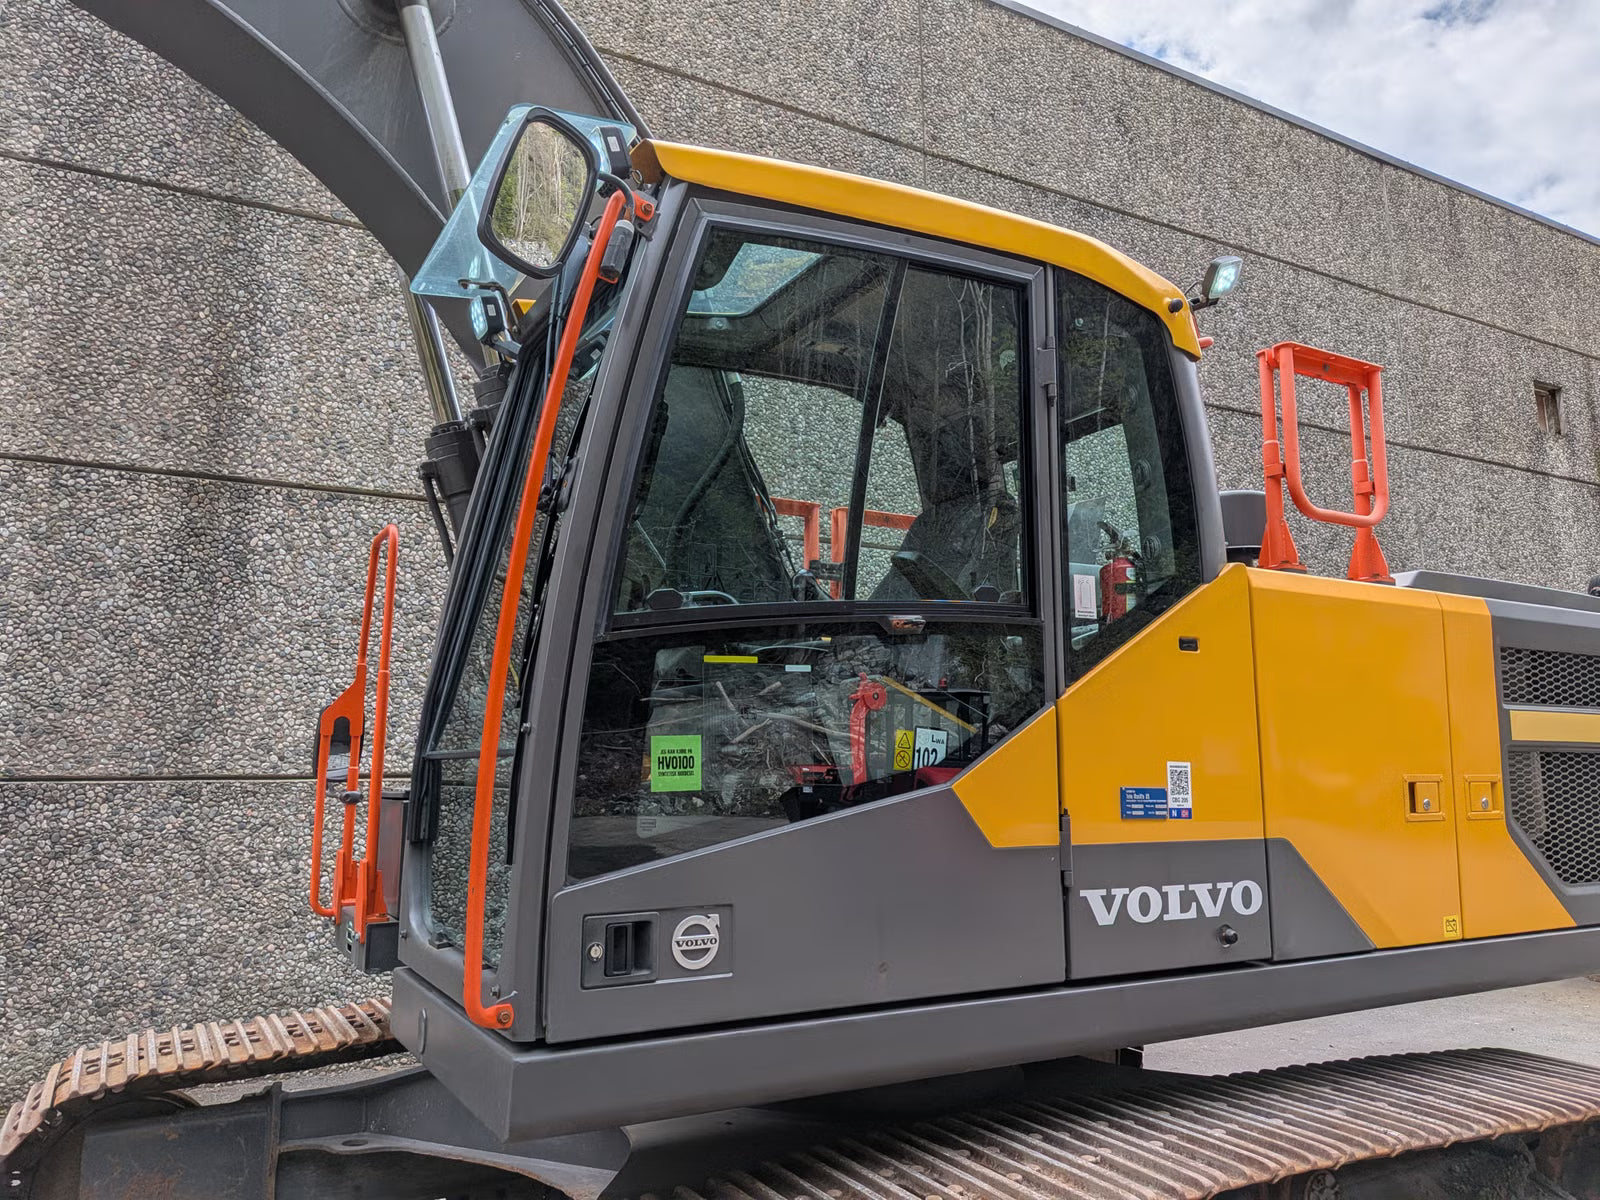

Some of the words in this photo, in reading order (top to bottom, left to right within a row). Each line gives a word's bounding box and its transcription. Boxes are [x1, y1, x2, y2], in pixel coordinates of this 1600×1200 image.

[916, 746, 937, 768] 102
[1080, 879, 1263, 926] VOLVO
[674, 938, 717, 947] VOLVO
